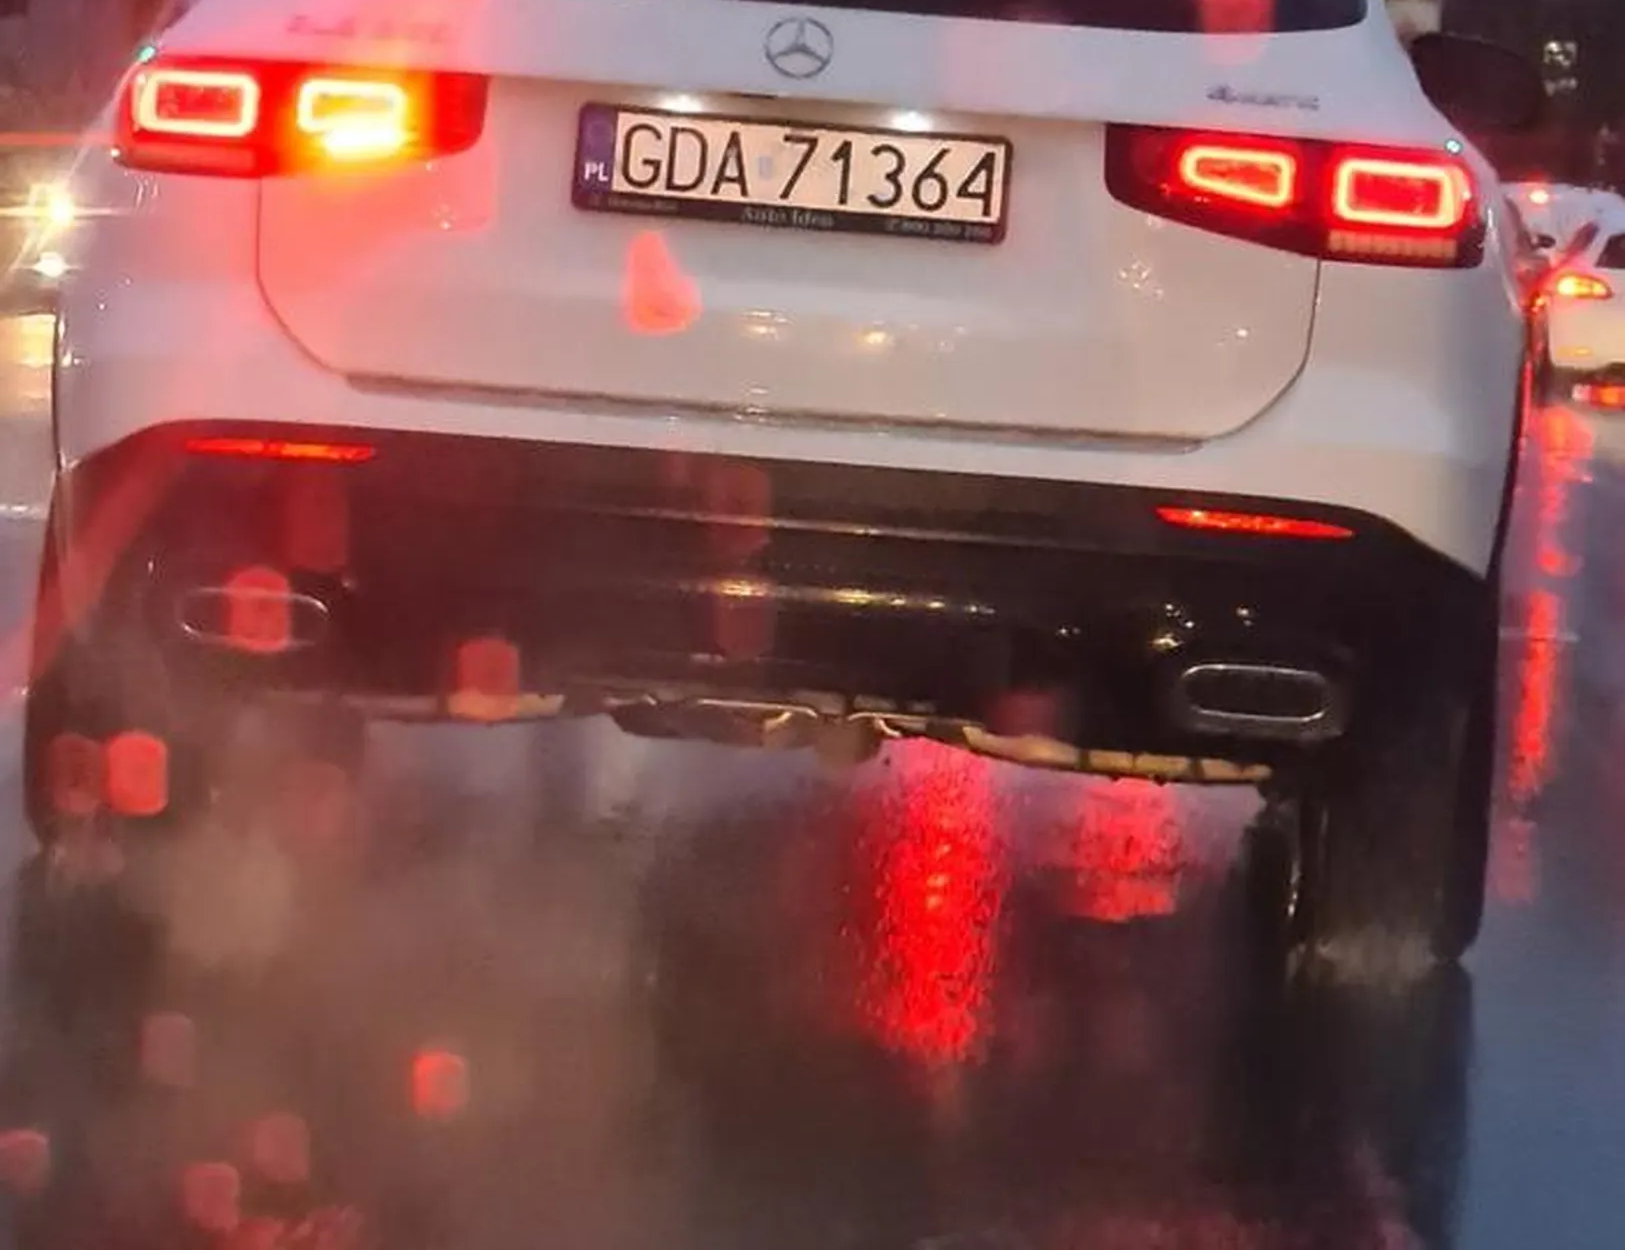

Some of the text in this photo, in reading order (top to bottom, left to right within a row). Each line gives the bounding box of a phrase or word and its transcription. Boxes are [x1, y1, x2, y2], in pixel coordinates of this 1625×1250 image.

[584, 161, 609, 182] PL
[621, 123, 996, 217] GDA 71364
